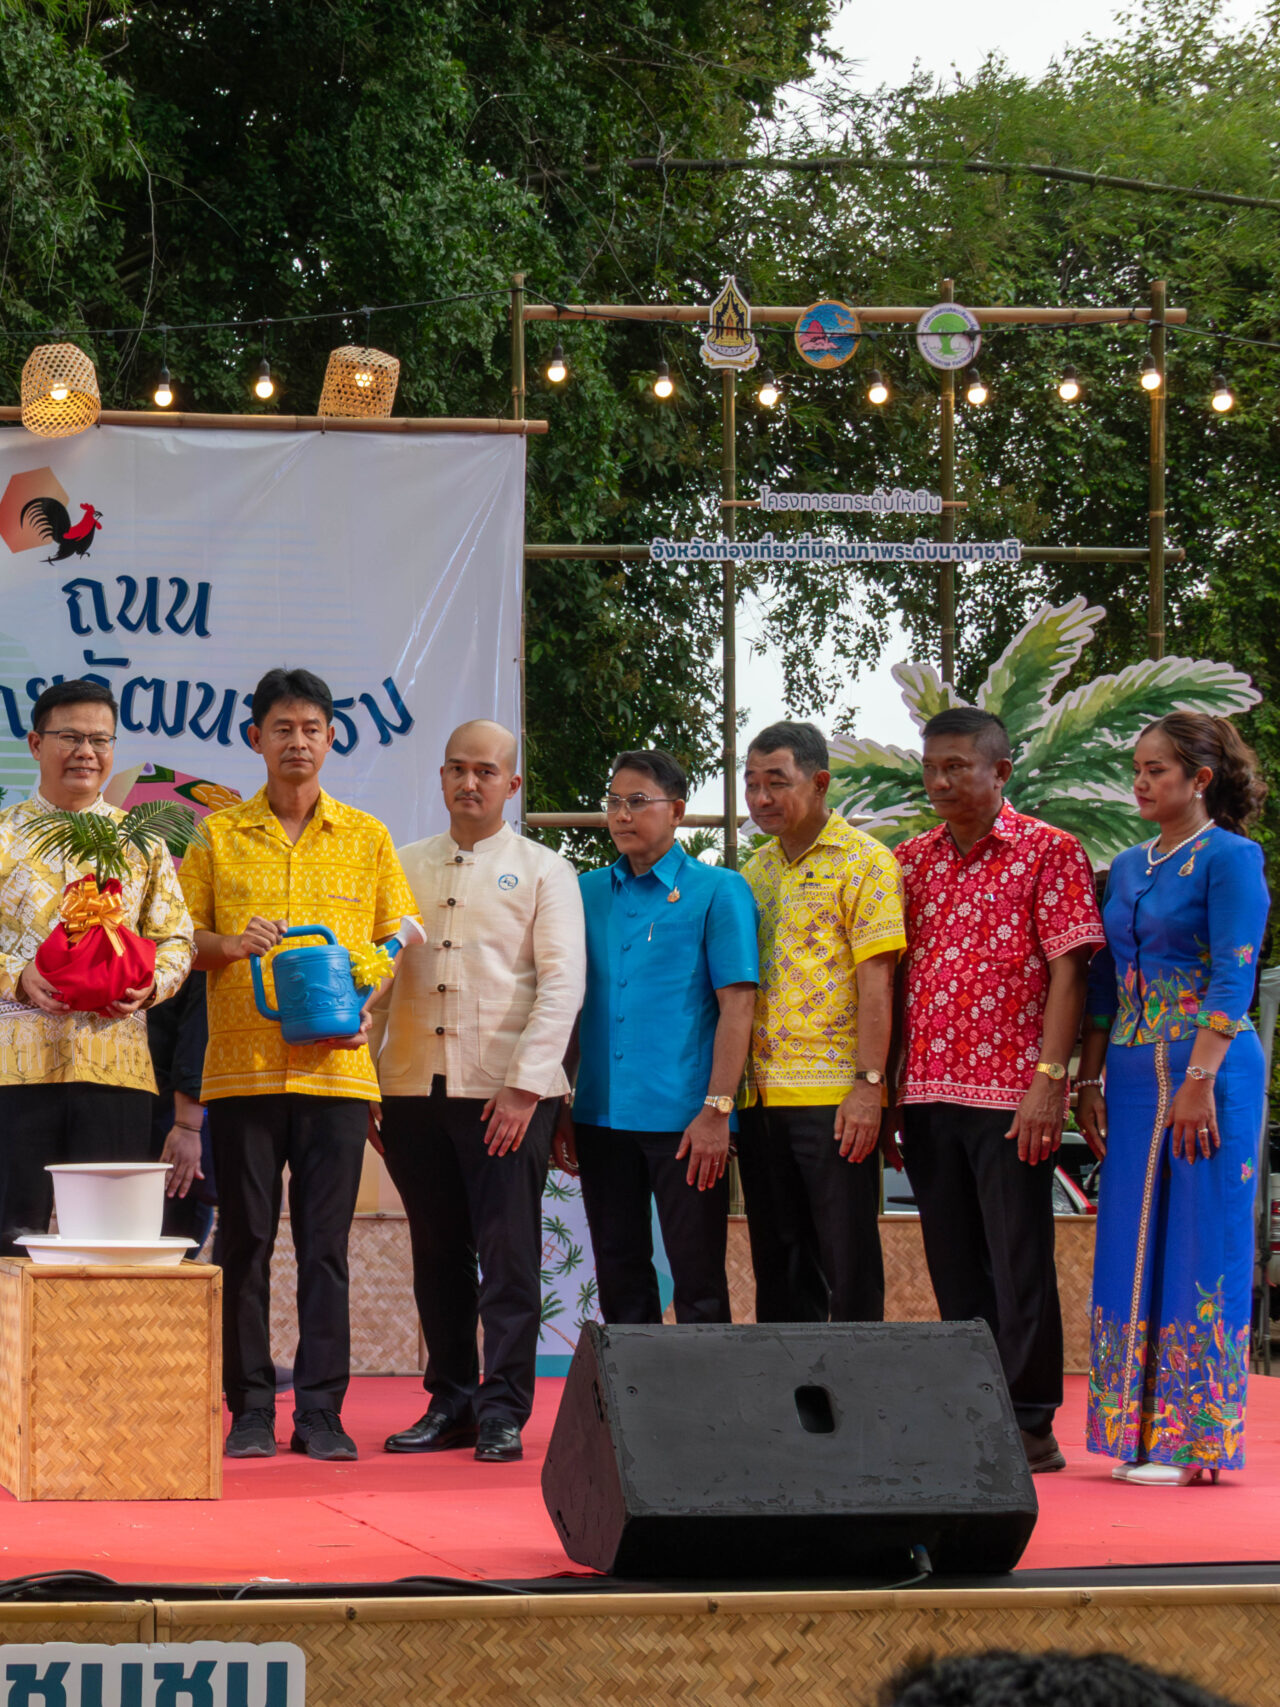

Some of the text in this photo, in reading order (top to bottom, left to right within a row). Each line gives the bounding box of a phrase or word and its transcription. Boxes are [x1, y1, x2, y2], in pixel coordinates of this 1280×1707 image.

[760, 487, 941, 512] โครงการยกระดับให้เป็น
[651, 533, 1019, 565] จังหวัดท่องเที่ยวที่มีคุณภาพระดับนานาชาติ
[61, 575, 210, 637] ถนน
